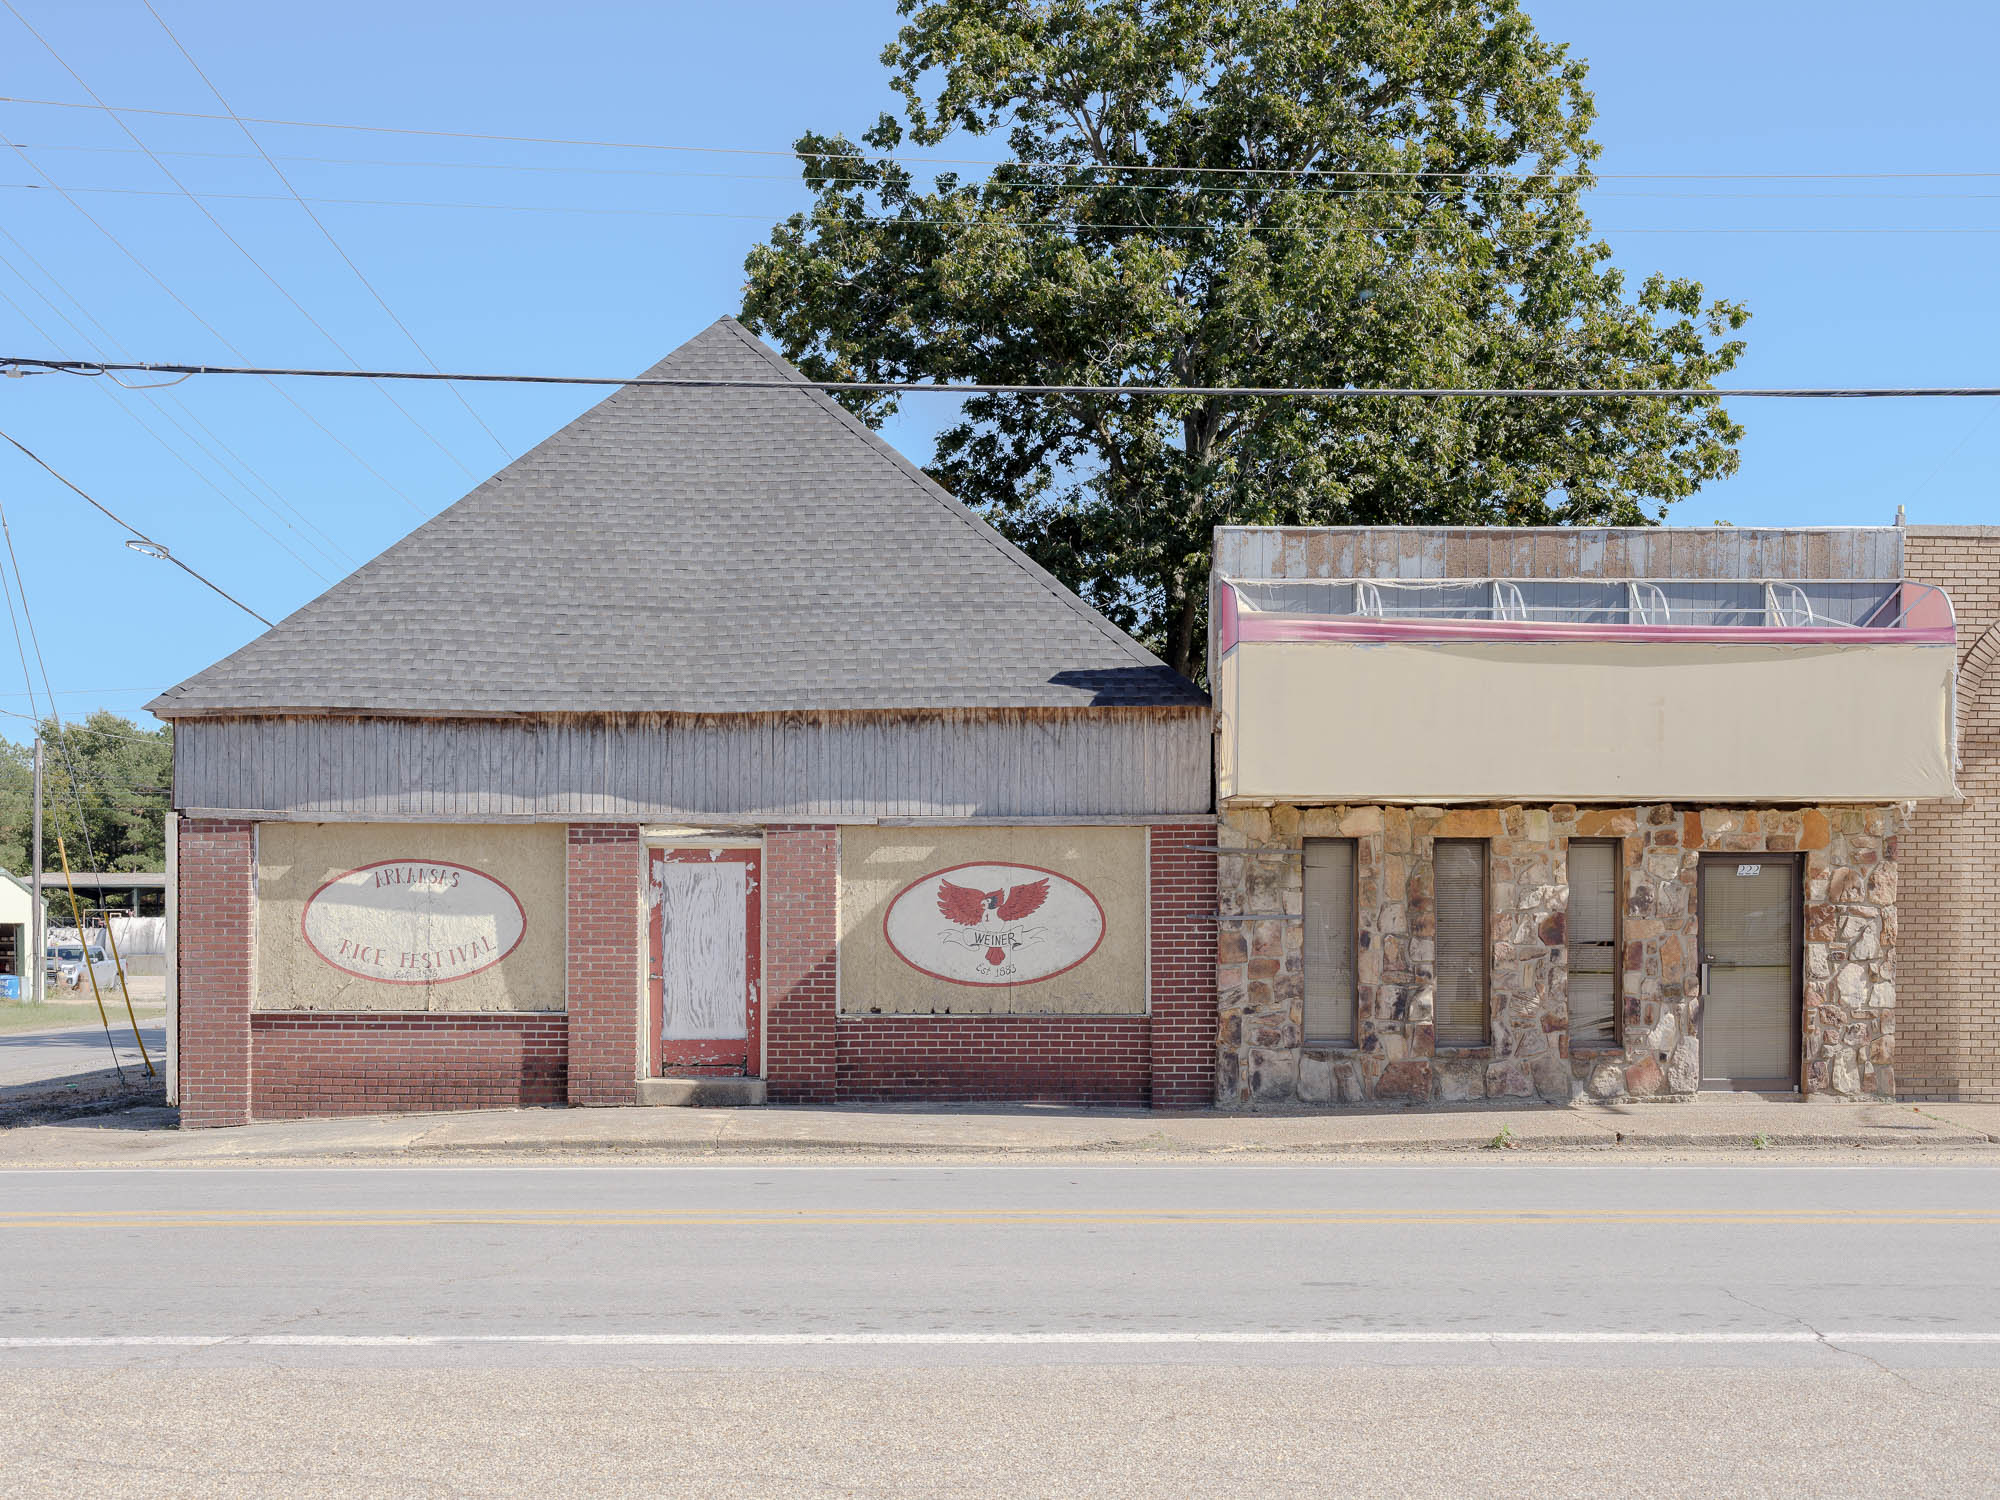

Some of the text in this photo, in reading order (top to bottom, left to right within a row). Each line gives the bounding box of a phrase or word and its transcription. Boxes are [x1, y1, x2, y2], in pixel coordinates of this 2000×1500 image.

[375, 867, 460, 889] ARKANSAS
[1738, 865, 1760, 875] 222
[974, 931, 1017, 947] WEINER
[338, 935, 497, 969] RICE FESTIVAL
[975, 963, 1017, 978] Est 1883
